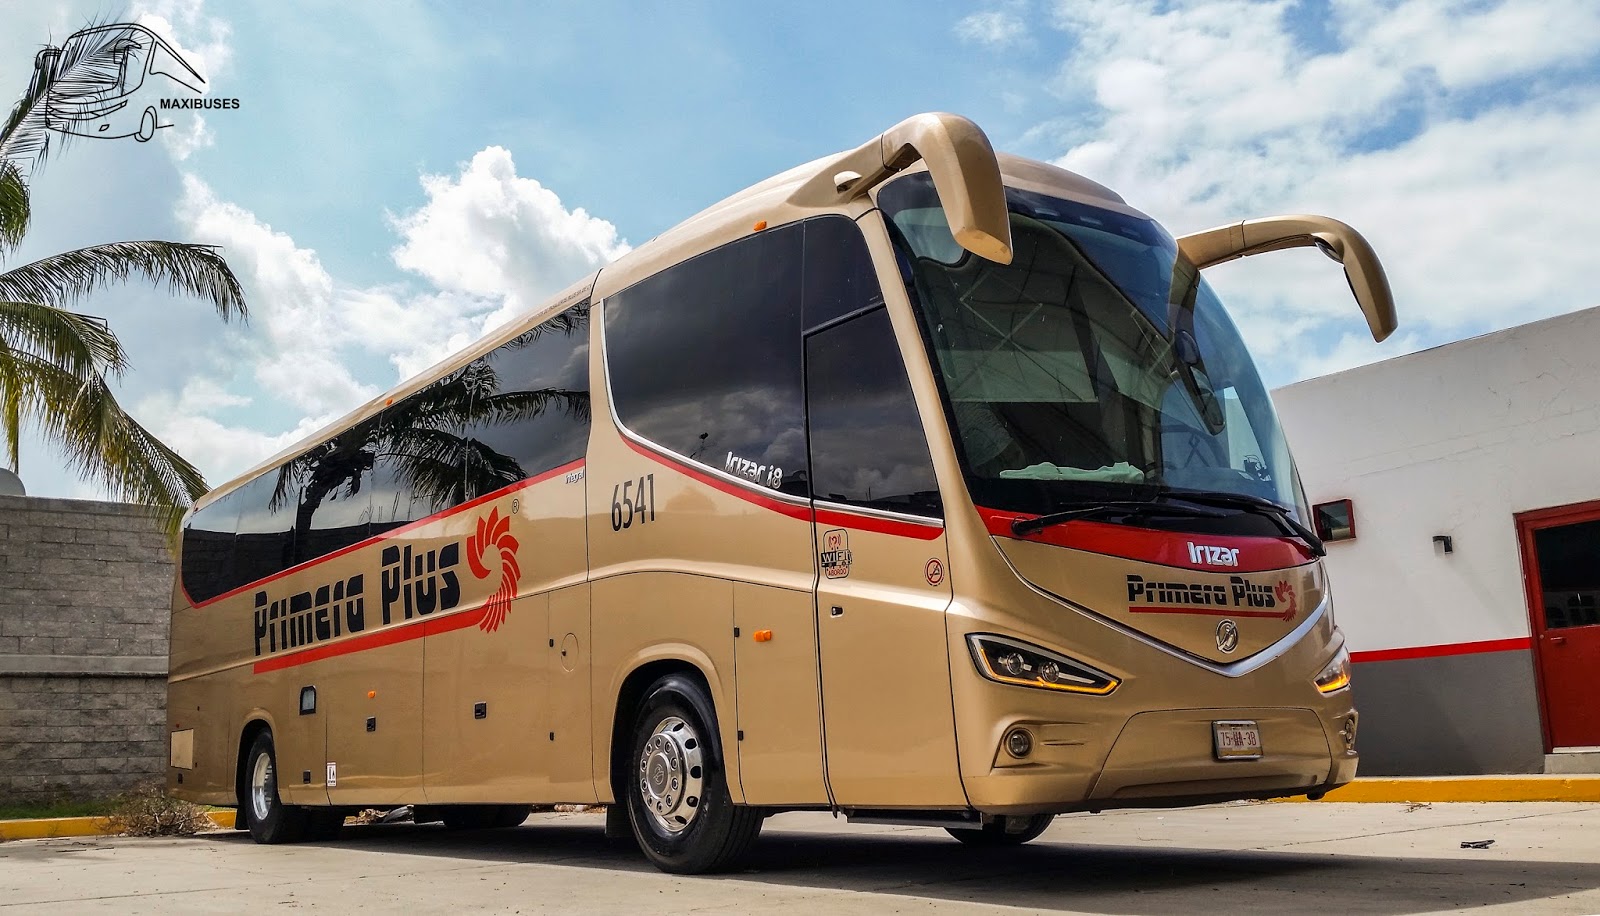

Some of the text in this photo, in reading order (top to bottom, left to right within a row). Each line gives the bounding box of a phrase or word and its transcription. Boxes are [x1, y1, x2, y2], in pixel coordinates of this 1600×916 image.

[725, 451, 783, 490] Irizar i8
[611, 473, 655, 532] 6541
[1187, 541, 1240, 567] Irizar
[254, 541, 461, 657] Primera Plus
[1127, 574, 1276, 608] Primera Plus
